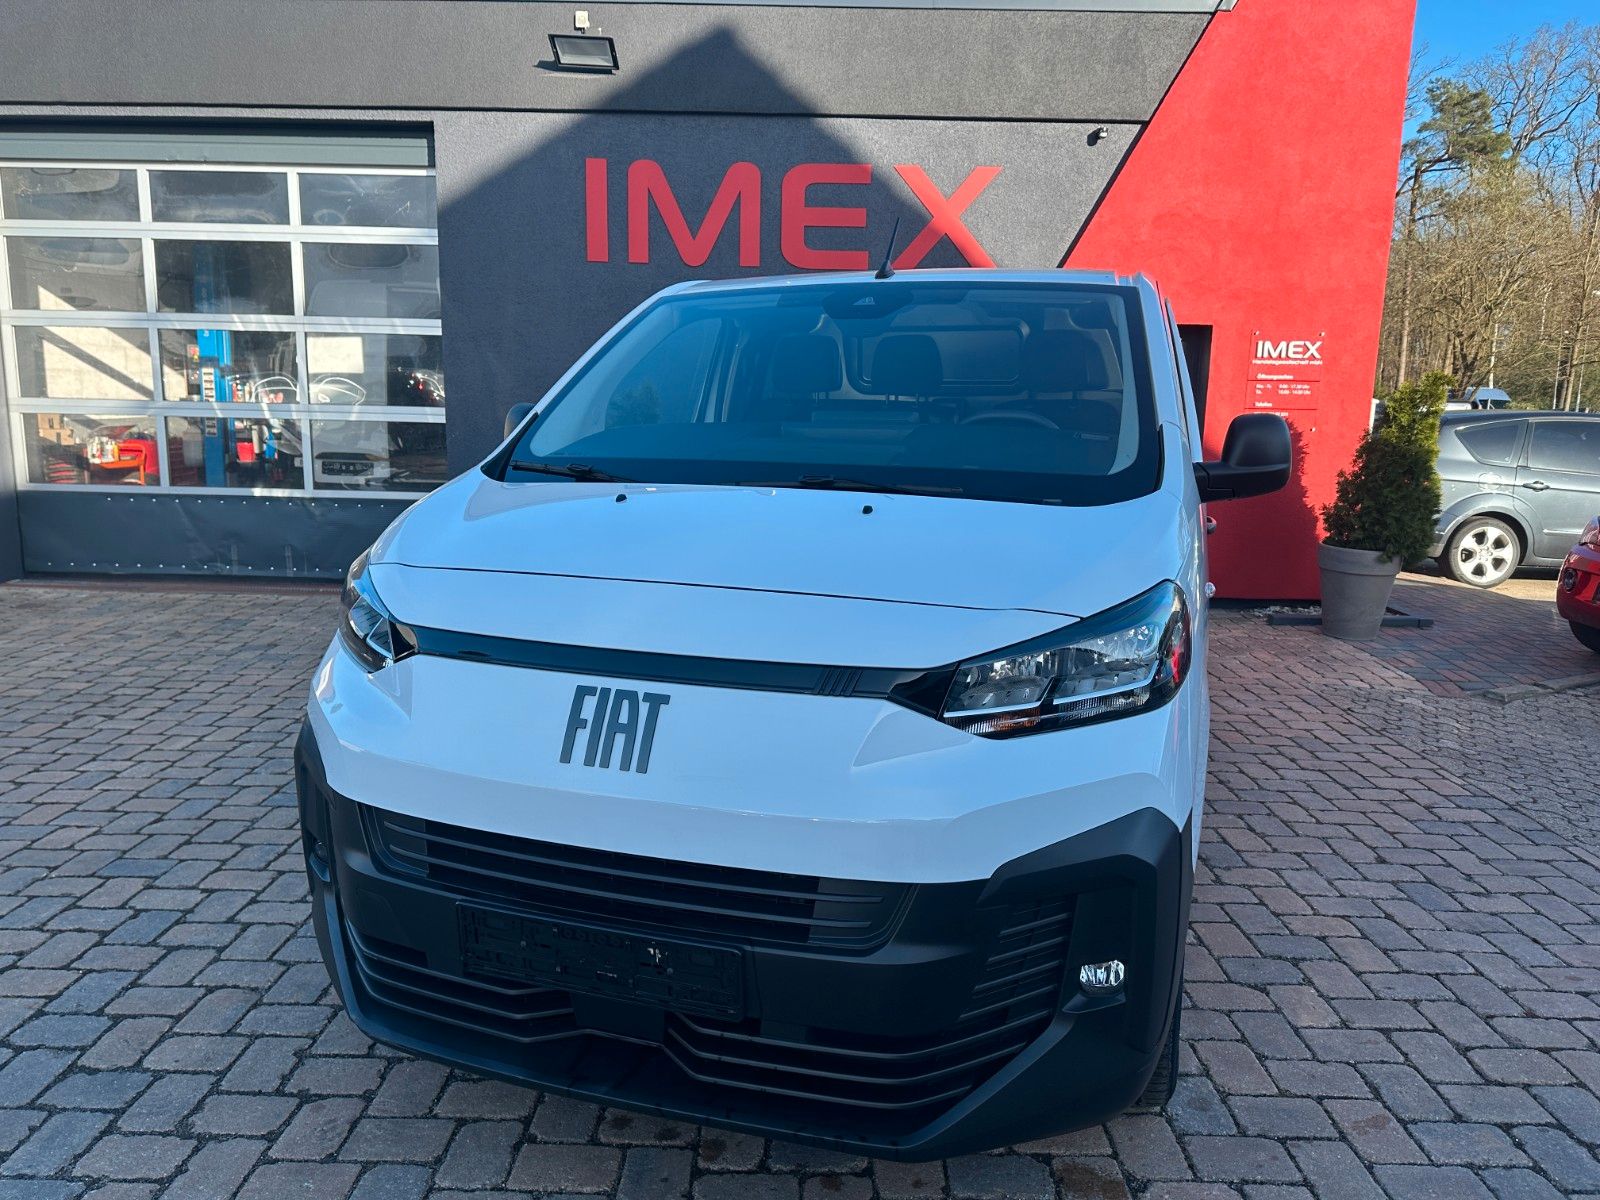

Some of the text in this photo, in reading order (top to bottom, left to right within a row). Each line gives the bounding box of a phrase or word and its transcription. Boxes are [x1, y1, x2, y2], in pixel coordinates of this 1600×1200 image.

[585, 157, 1003, 270] IMEX
[1256, 340, 1322, 359] IMEX
[559, 684, 671, 774] FIAT
